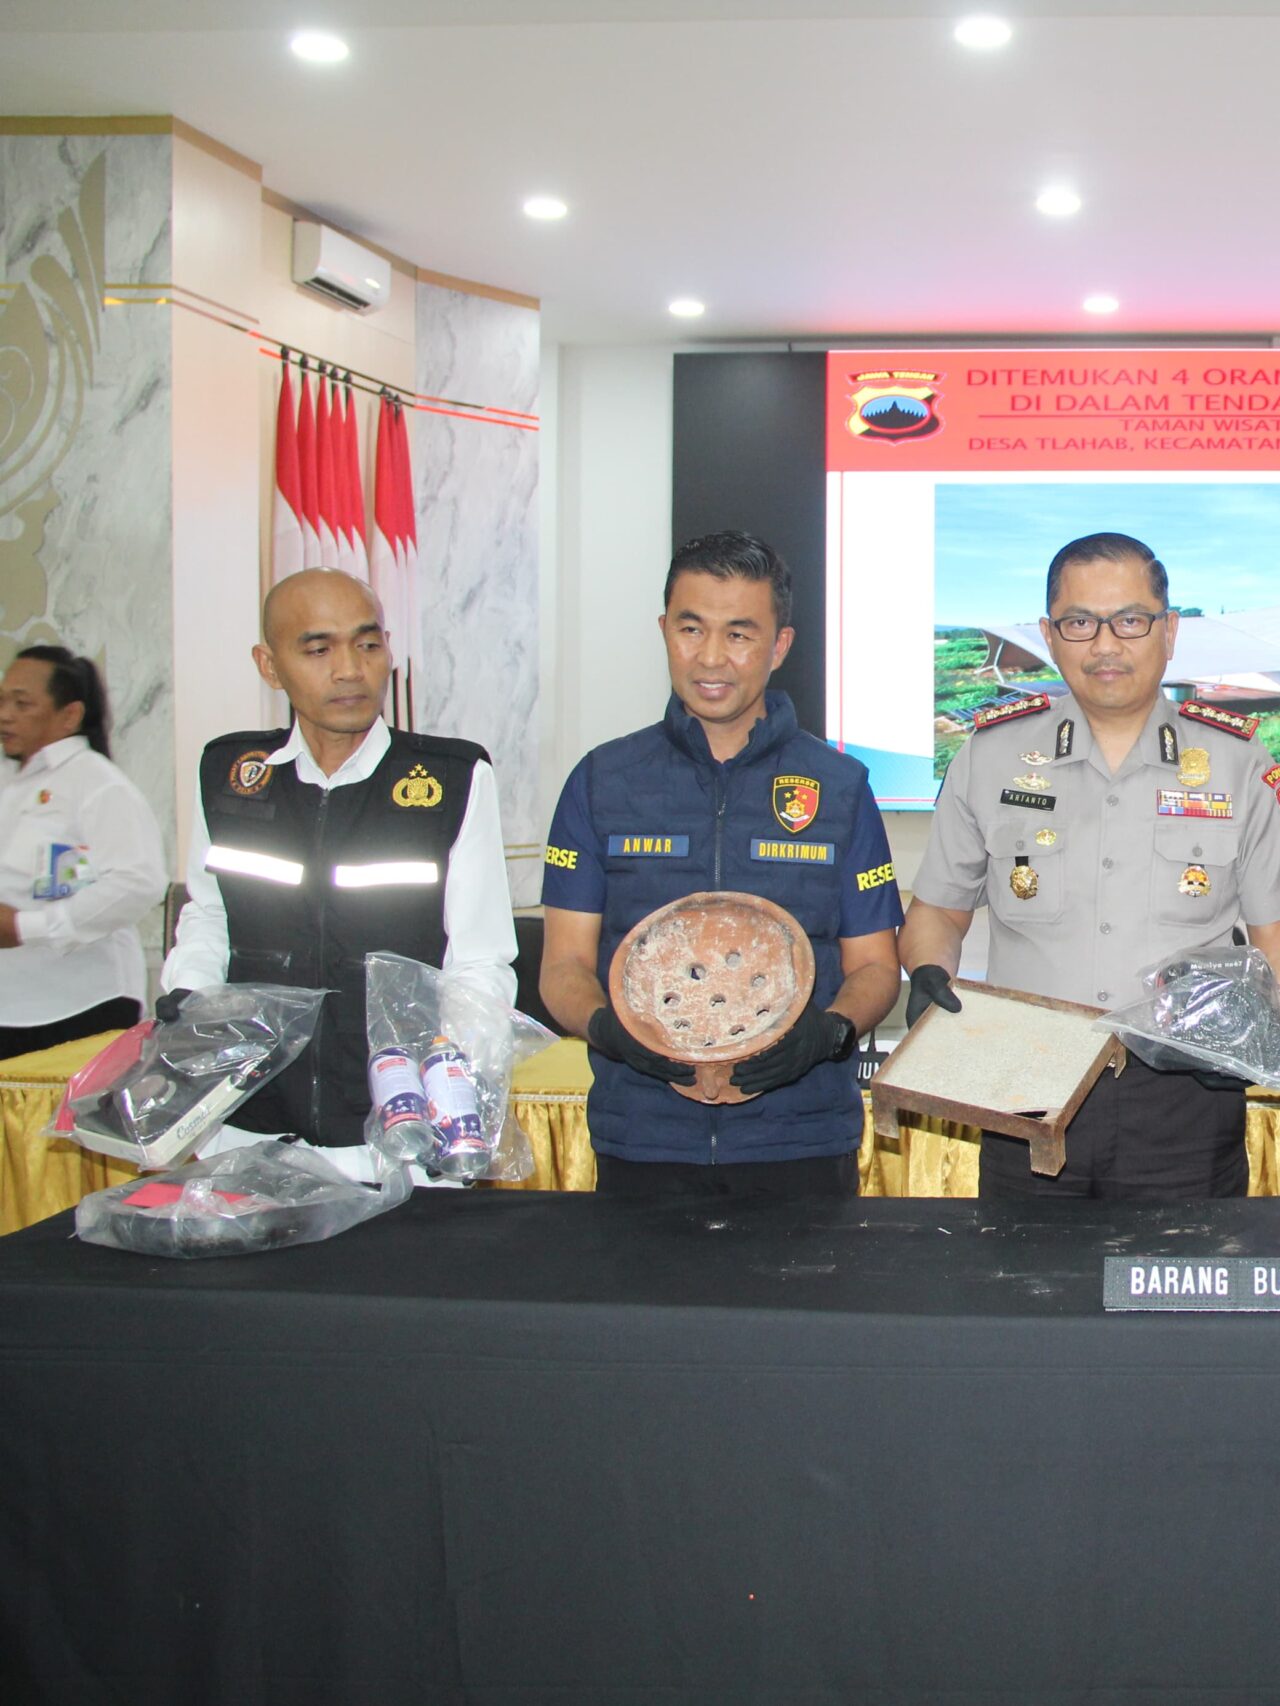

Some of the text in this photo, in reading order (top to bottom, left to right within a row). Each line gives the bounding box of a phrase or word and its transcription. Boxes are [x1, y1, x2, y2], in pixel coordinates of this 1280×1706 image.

[966, 368, 1158, 386] DITEMUKAN
[1171, 368, 1190, 386] 4
[1010, 394, 1041, 412] DI
[1055, 394, 1170, 412] DALAM
[1119, 418, 1205, 432] TAMAN
[968, 437, 1028, 450] DESA
[1035, 437, 1135, 452] TLAHAB,
[1009, 793, 1048, 806] ARIANTO
[623, 837, 672, 853] ANWAR
[758, 842, 828, 861] DIRKRIMUM
[1130, 1266, 1229, 1295] BARANG
